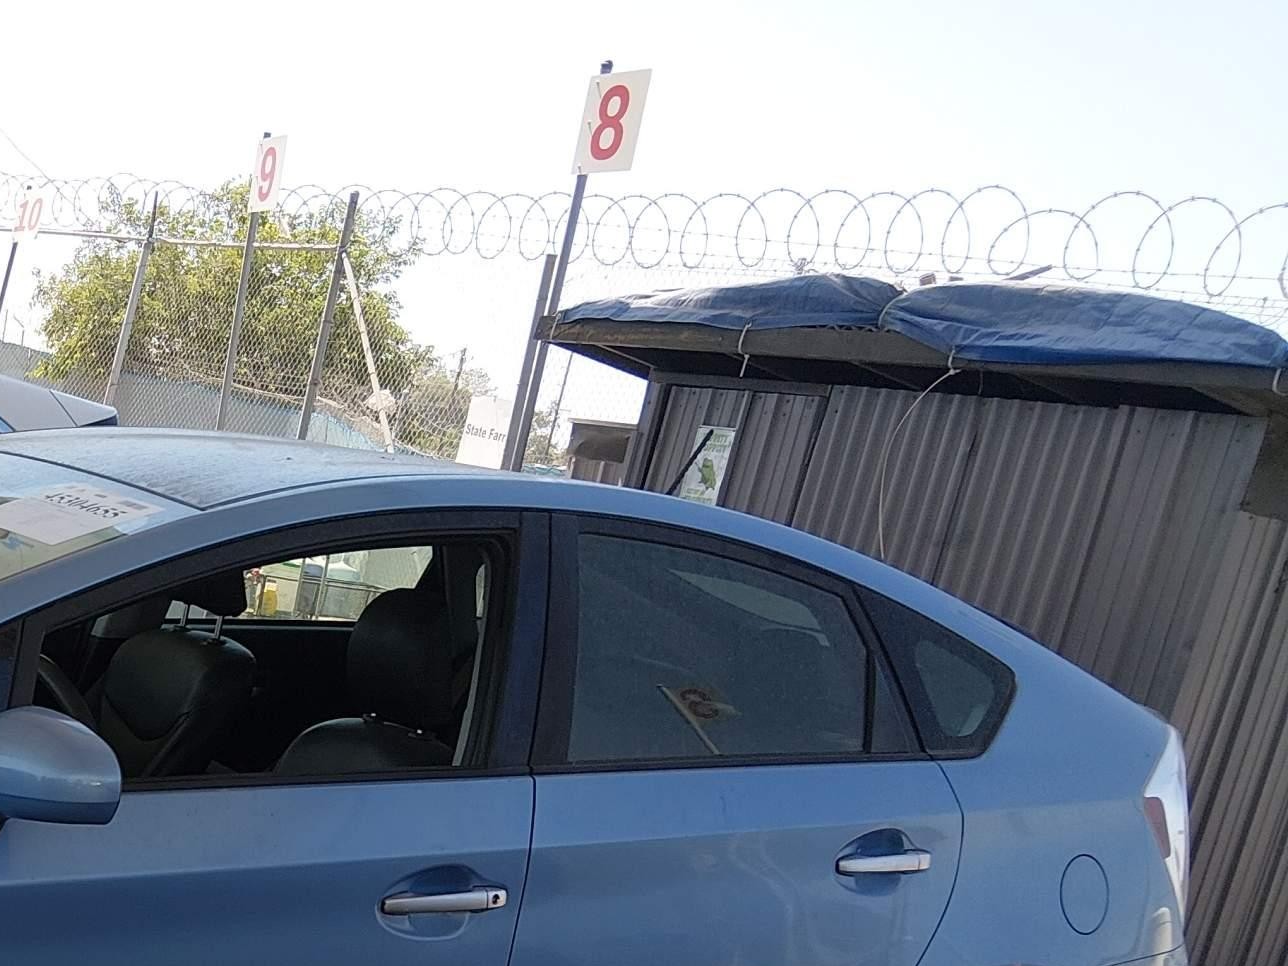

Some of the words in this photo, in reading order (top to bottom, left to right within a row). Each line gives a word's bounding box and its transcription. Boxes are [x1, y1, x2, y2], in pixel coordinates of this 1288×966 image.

[590, 84, 630, 161] 8
[258, 146, 277, 202] 9
[14, 198, 43, 232] 10
[465, 423, 487, 439] State
